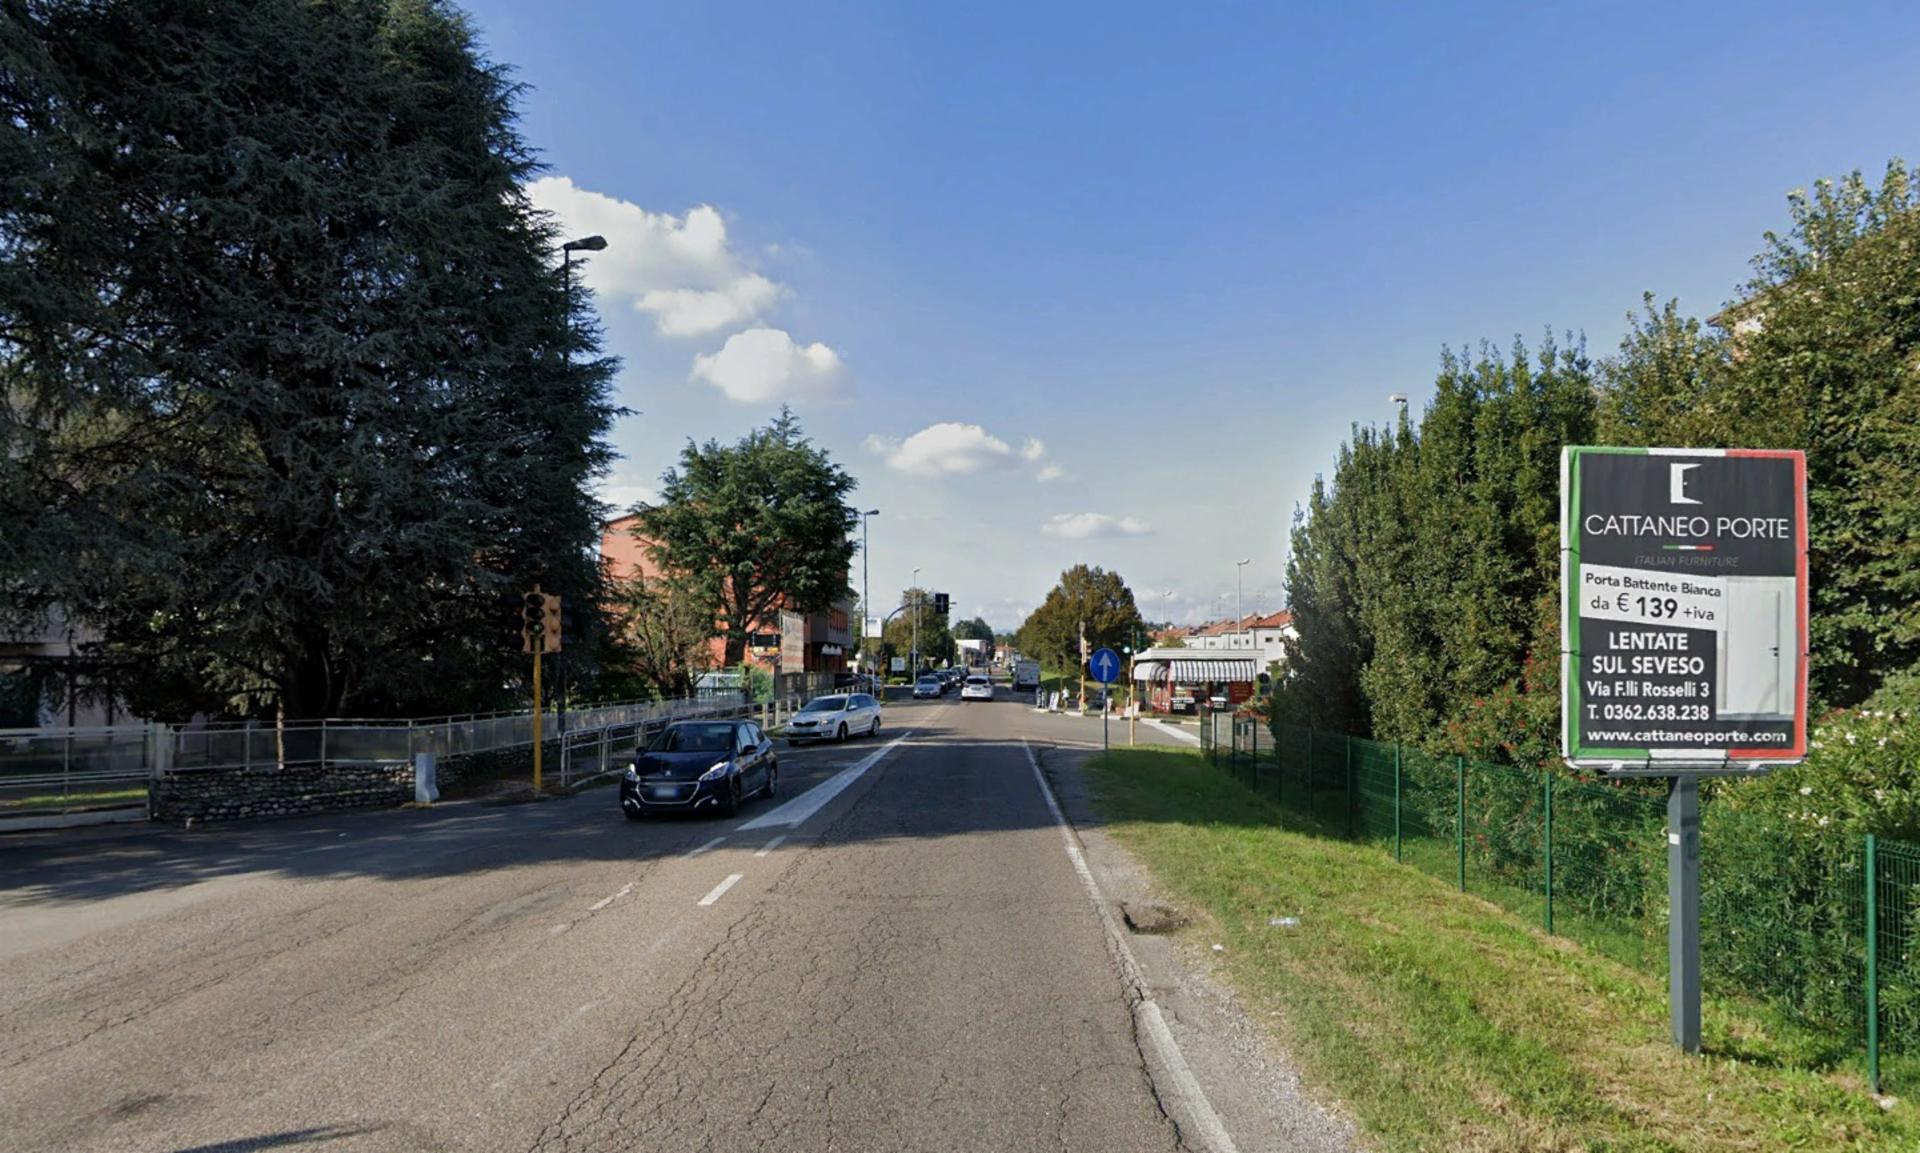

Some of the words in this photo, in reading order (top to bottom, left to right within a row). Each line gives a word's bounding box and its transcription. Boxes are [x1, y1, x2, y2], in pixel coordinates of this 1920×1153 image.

[1585, 514, 1710, 538] CATTANEO
[1716, 516, 1790, 539] PORTE
[1634, 555, 1675, 566] ITALIAN
[1585, 572, 1621, 587] Porta
[1623, 576, 1679, 593] Battente
[1681, 582, 1722, 598] Bianca
[1590, 595, 1610, 611] da
[1616, 592, 1631, 613] €
[1635, 596, 1679, 620] 139
[1683, 606, 1715, 621] +iva
[1608, 631, 1689, 651] LENTATE
[1592, 655, 1627, 674] SUL
[1631, 656, 1705, 675] SEVESO
[1586, 680, 1611, 697] Via
[1614, 680, 1639, 697] F.lli
[1642, 680, 1697, 698] Rosselli
[1700, 681, 1710, 698] 3
[1586, 704, 1600, 720] T.
[1603, 704, 1710, 721] 0362.638.238
[1586, 729, 1787, 745] www.cattaneoporte.com
